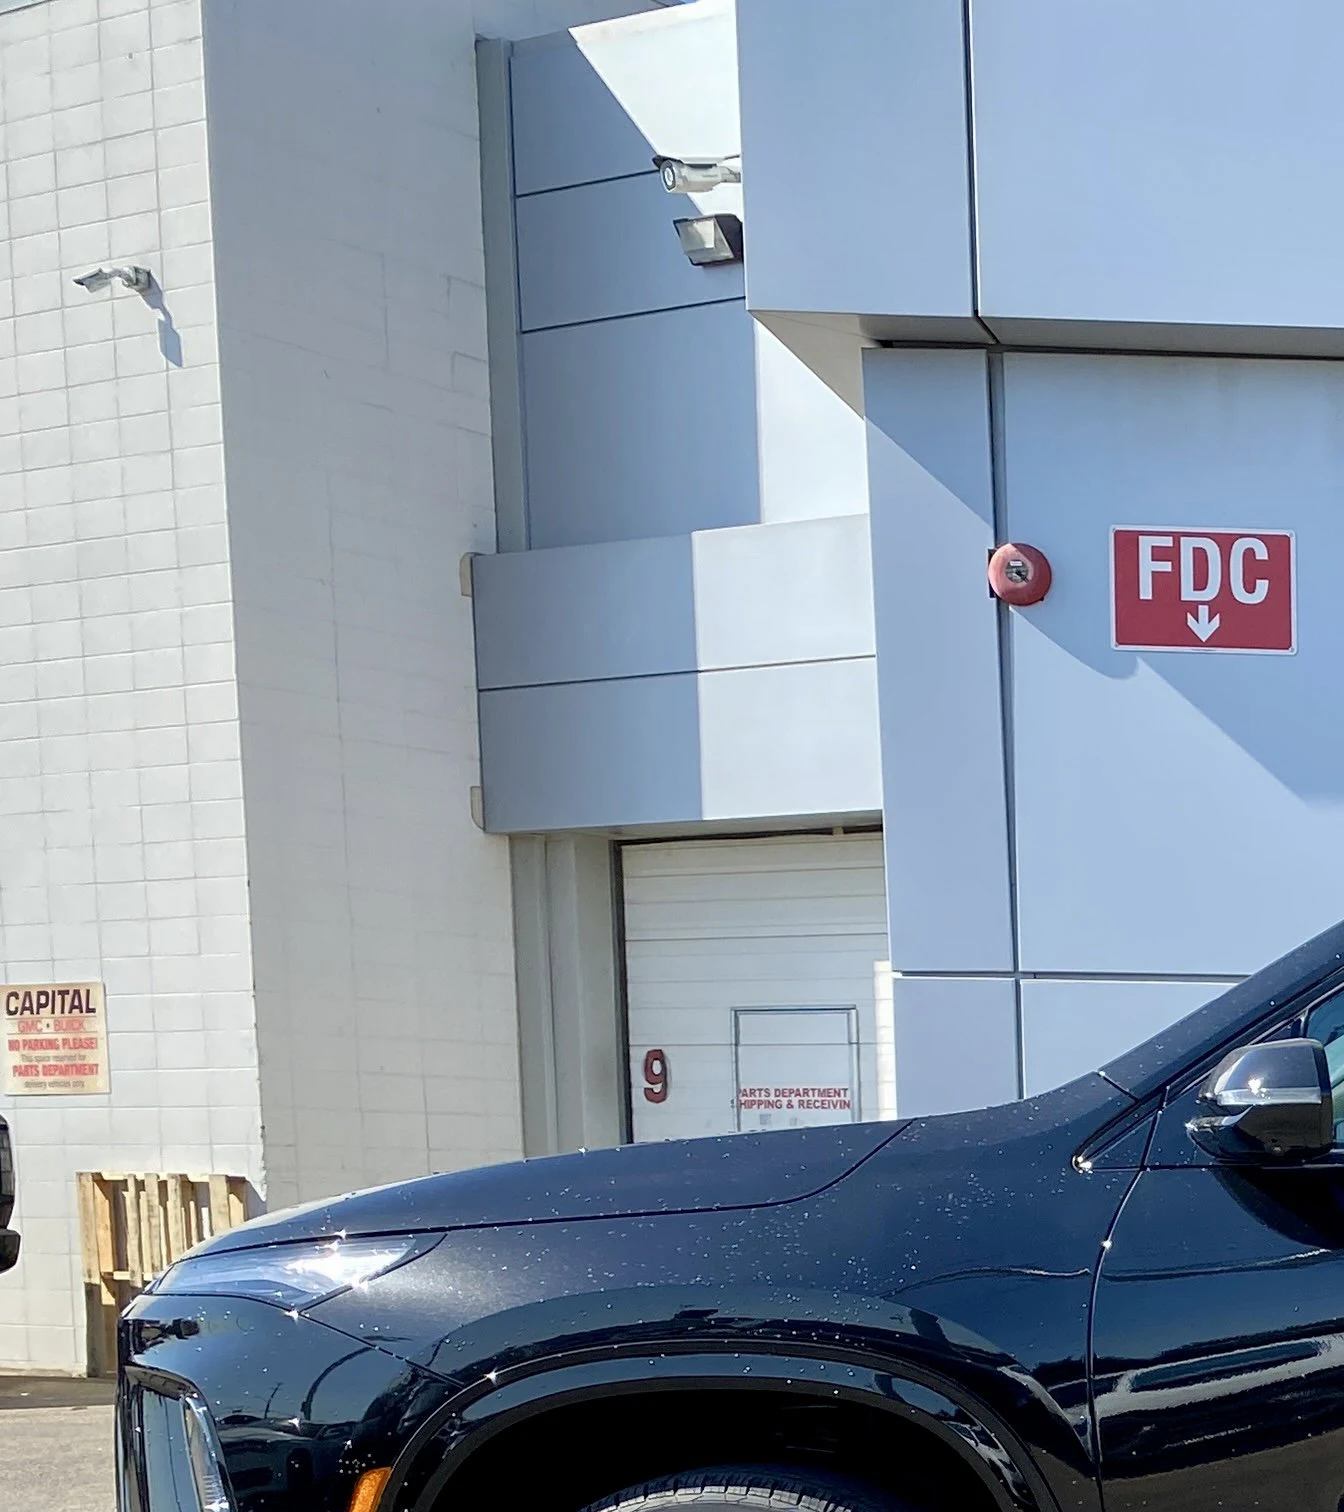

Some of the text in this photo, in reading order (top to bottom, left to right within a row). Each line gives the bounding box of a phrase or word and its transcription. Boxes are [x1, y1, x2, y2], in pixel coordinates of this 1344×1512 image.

[1137, 535, 1270, 604] FDC
[6, 989, 96, 1016] CAPITAL
[17, 1017, 85, 1032] GMC BUICK
[8, 1039, 20, 1051] NO
[22, 1038, 60, 1051] PARKING
[12, 1064, 99, 1077] PARTS DEPARTMENT
[644, 1049, 669, 1104] 9
[739, 1088, 849, 1098] ARTS DEPARTMENT
[786, 1100, 794, 1109] &
[798, 1099, 851, 1110] RECEIVIN
